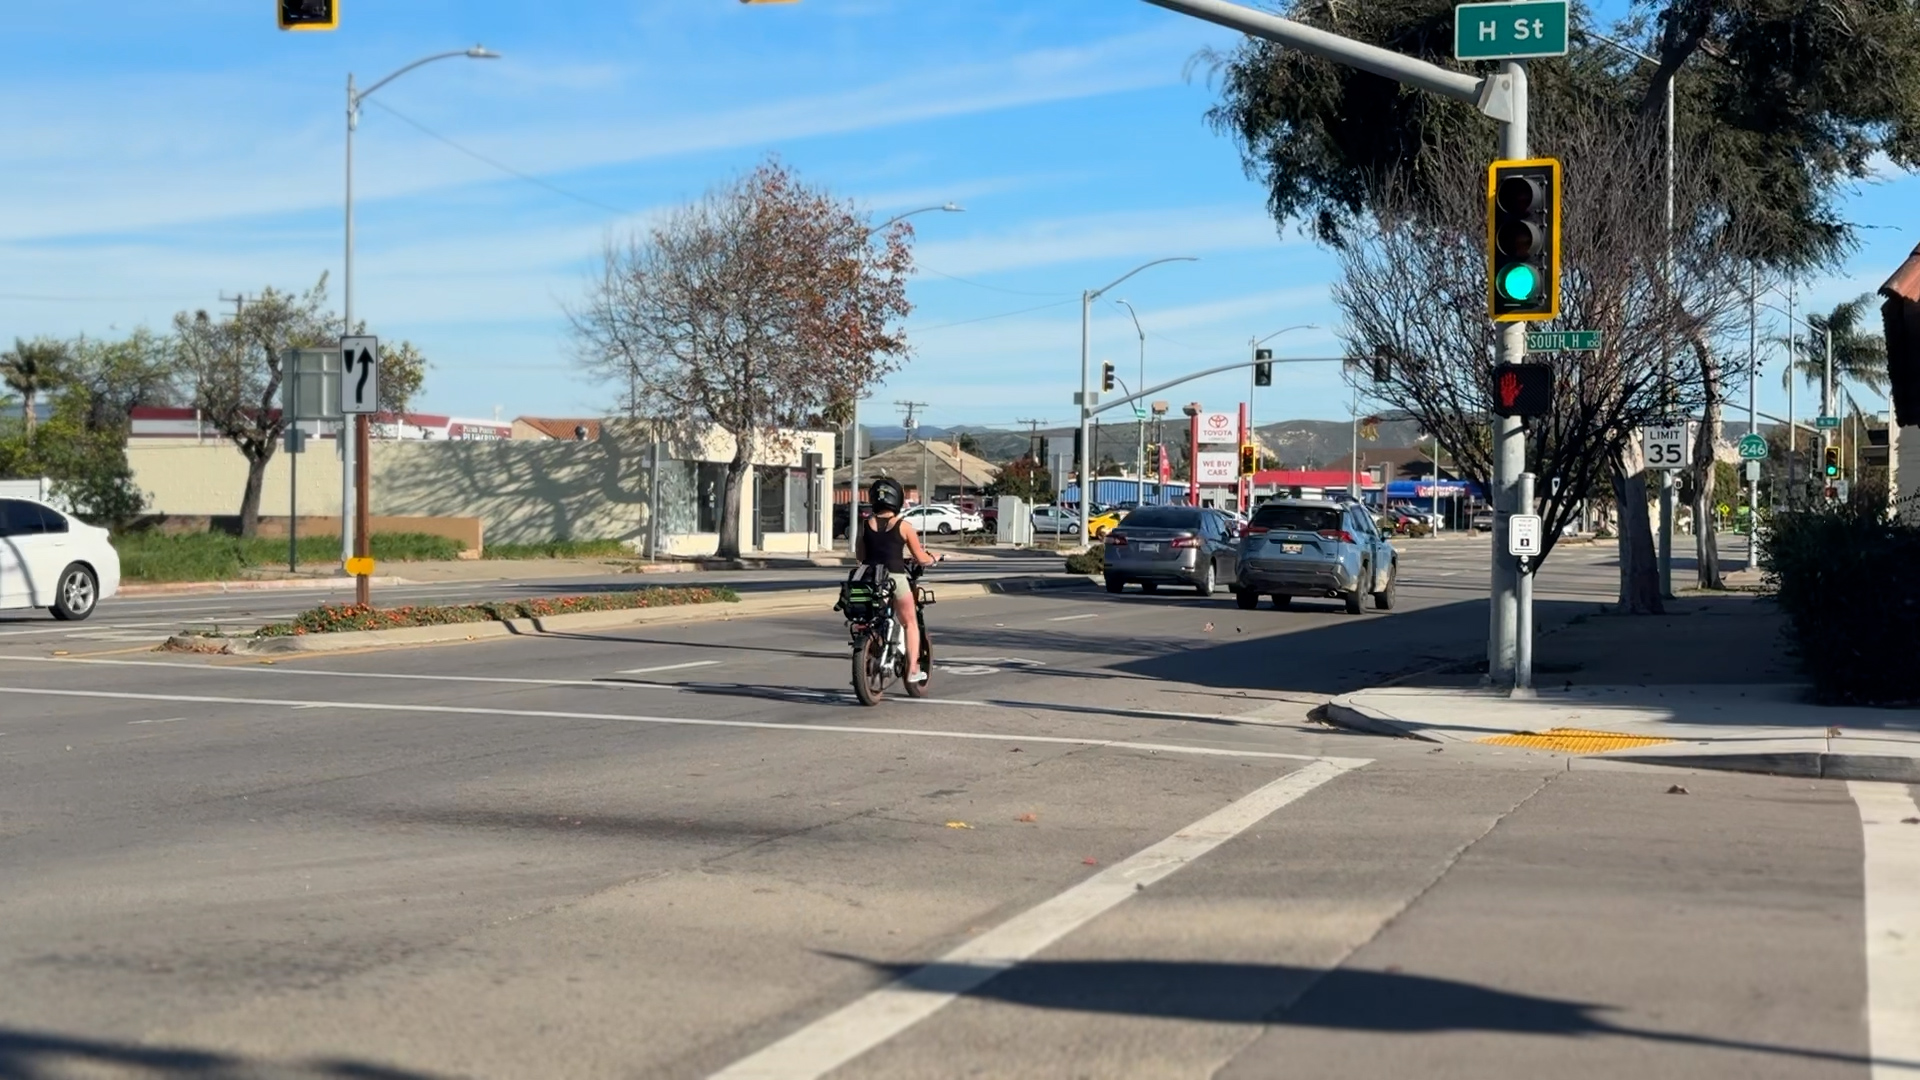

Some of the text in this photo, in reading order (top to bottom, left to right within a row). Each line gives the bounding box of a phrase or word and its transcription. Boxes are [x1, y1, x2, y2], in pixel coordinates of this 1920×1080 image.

[1478, 18, 1544, 41] H St
[1530, 334, 1565, 349] SOUTH
[1571, 334, 1579, 348] H
[1586, 340, 1600, 348] 100
[1650, 430, 1680, 440] LIMIT
[1648, 444, 1682, 464] 35
[1740, 444, 1766, 455] 246
